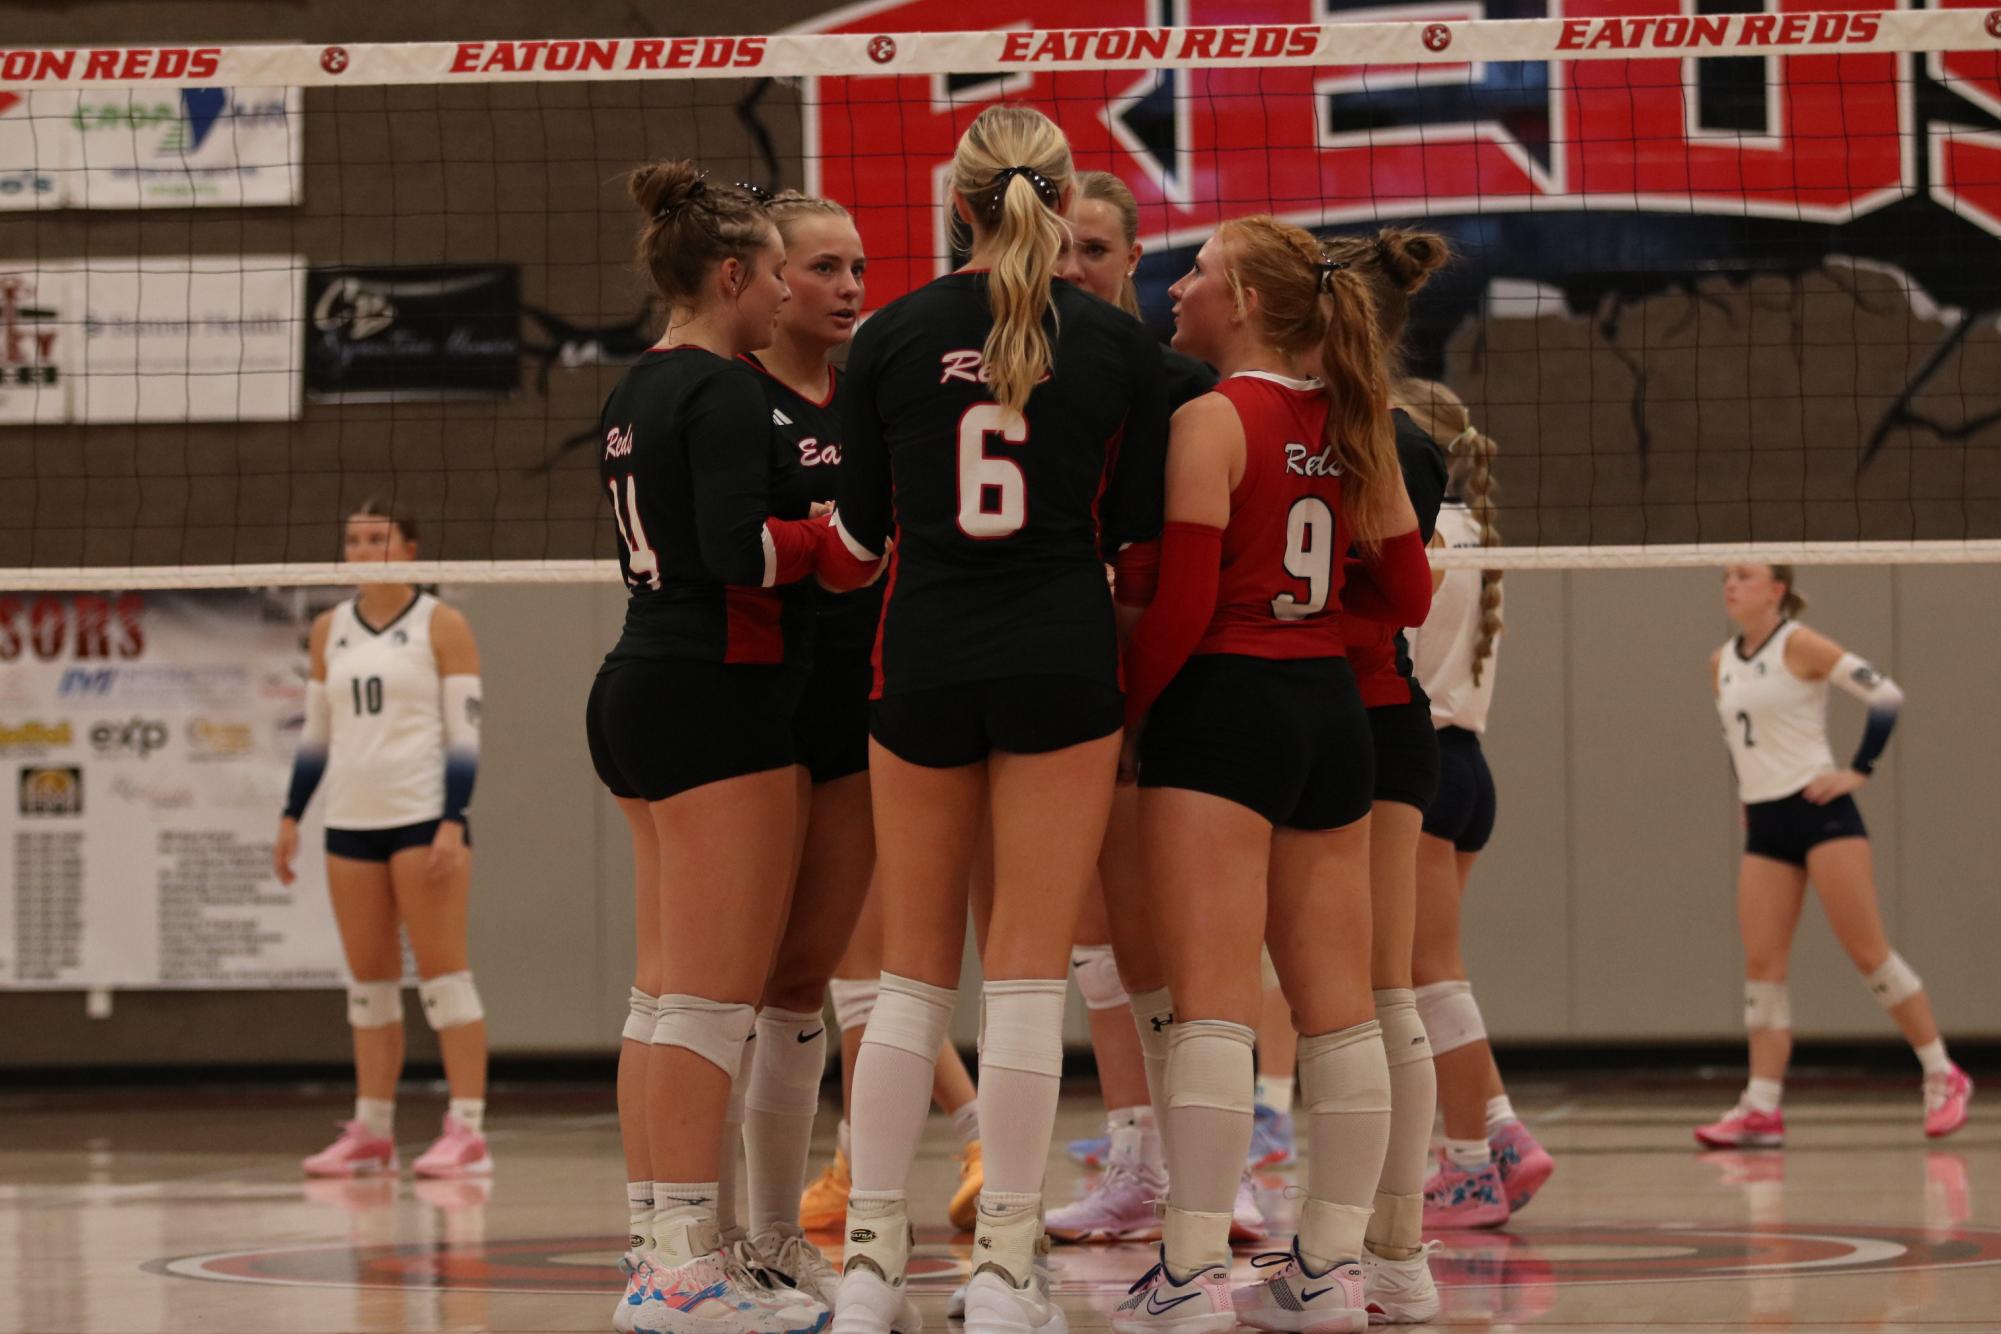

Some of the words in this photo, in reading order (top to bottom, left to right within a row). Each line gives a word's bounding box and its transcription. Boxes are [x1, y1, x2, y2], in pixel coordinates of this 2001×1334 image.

[998, 29, 1171, 62] EATON
[1177, 26, 1321, 59] REDS
[1554, 16, 1730, 50] EATON
[1735, 13, 1882, 46] REDS
[0, 50, 75, 81] ON
[81, 48, 221, 80] REDS
[449, 40, 619, 73] EATON
[625, 37, 768, 70] REDS
[605, 423, 633, 461] Reds
[956, 402, 1029, 540] 6
[1271, 496, 1334, 621] 9
[352, 676, 382, 716] 10
[1736, 711, 1754, 748] 2
